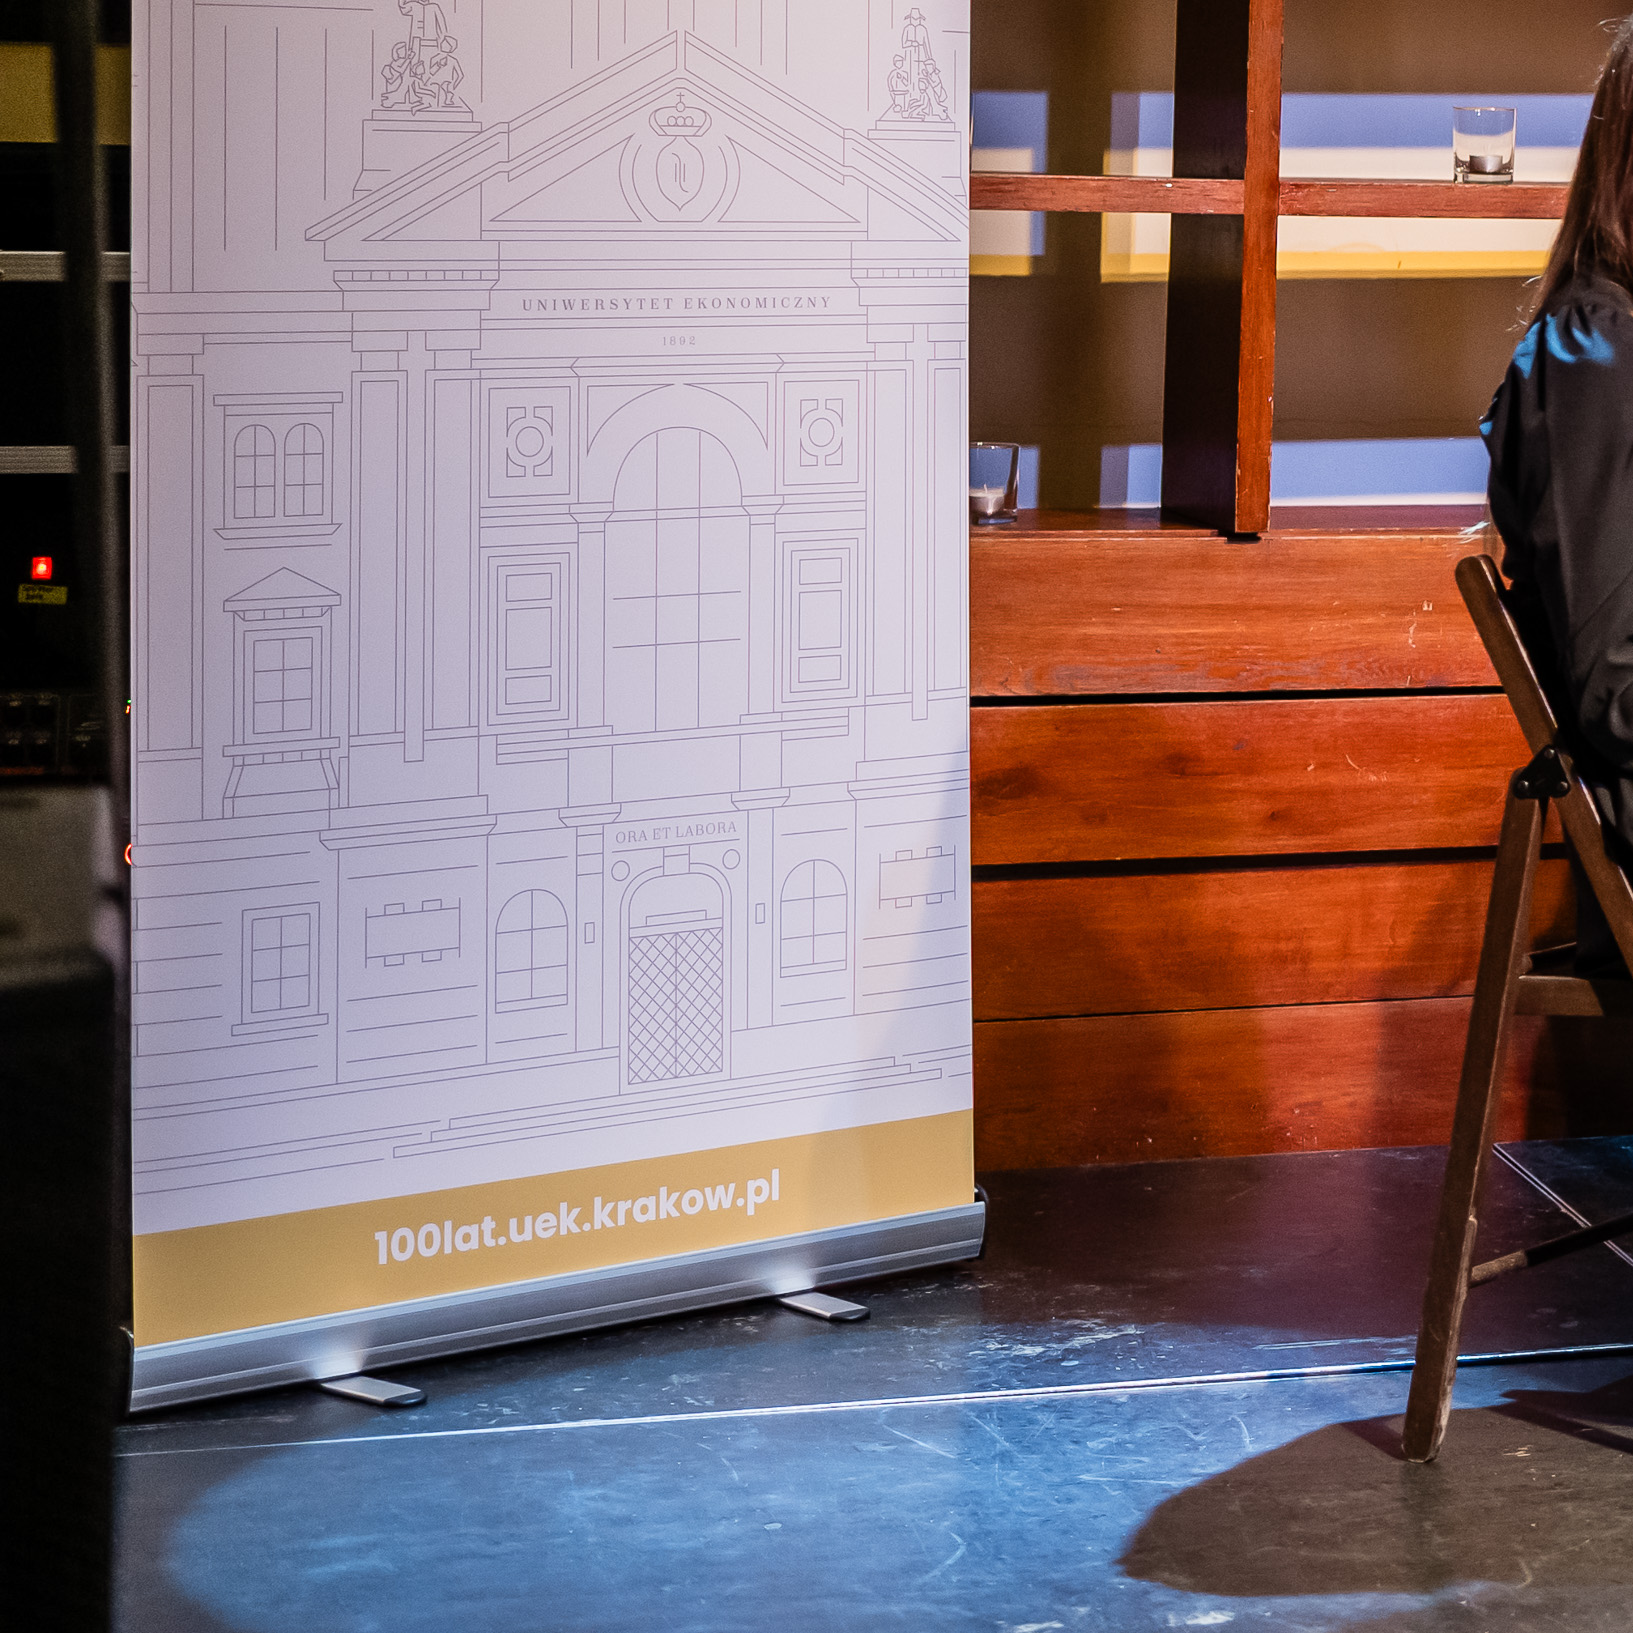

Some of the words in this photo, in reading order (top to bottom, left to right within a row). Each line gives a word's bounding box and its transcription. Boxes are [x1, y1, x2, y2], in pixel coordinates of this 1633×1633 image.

[522, 297, 675, 312] UNIWERSYTET
[683, 296, 832, 310] EKONOMICZNY
[661, 335, 697, 347] 1892
[615, 829, 648, 844] ORA
[652, 827, 672, 840] ET
[675, 821, 738, 838] LABORA
[374, 1168, 780, 1266] 100lat.uek.krakow.pl
